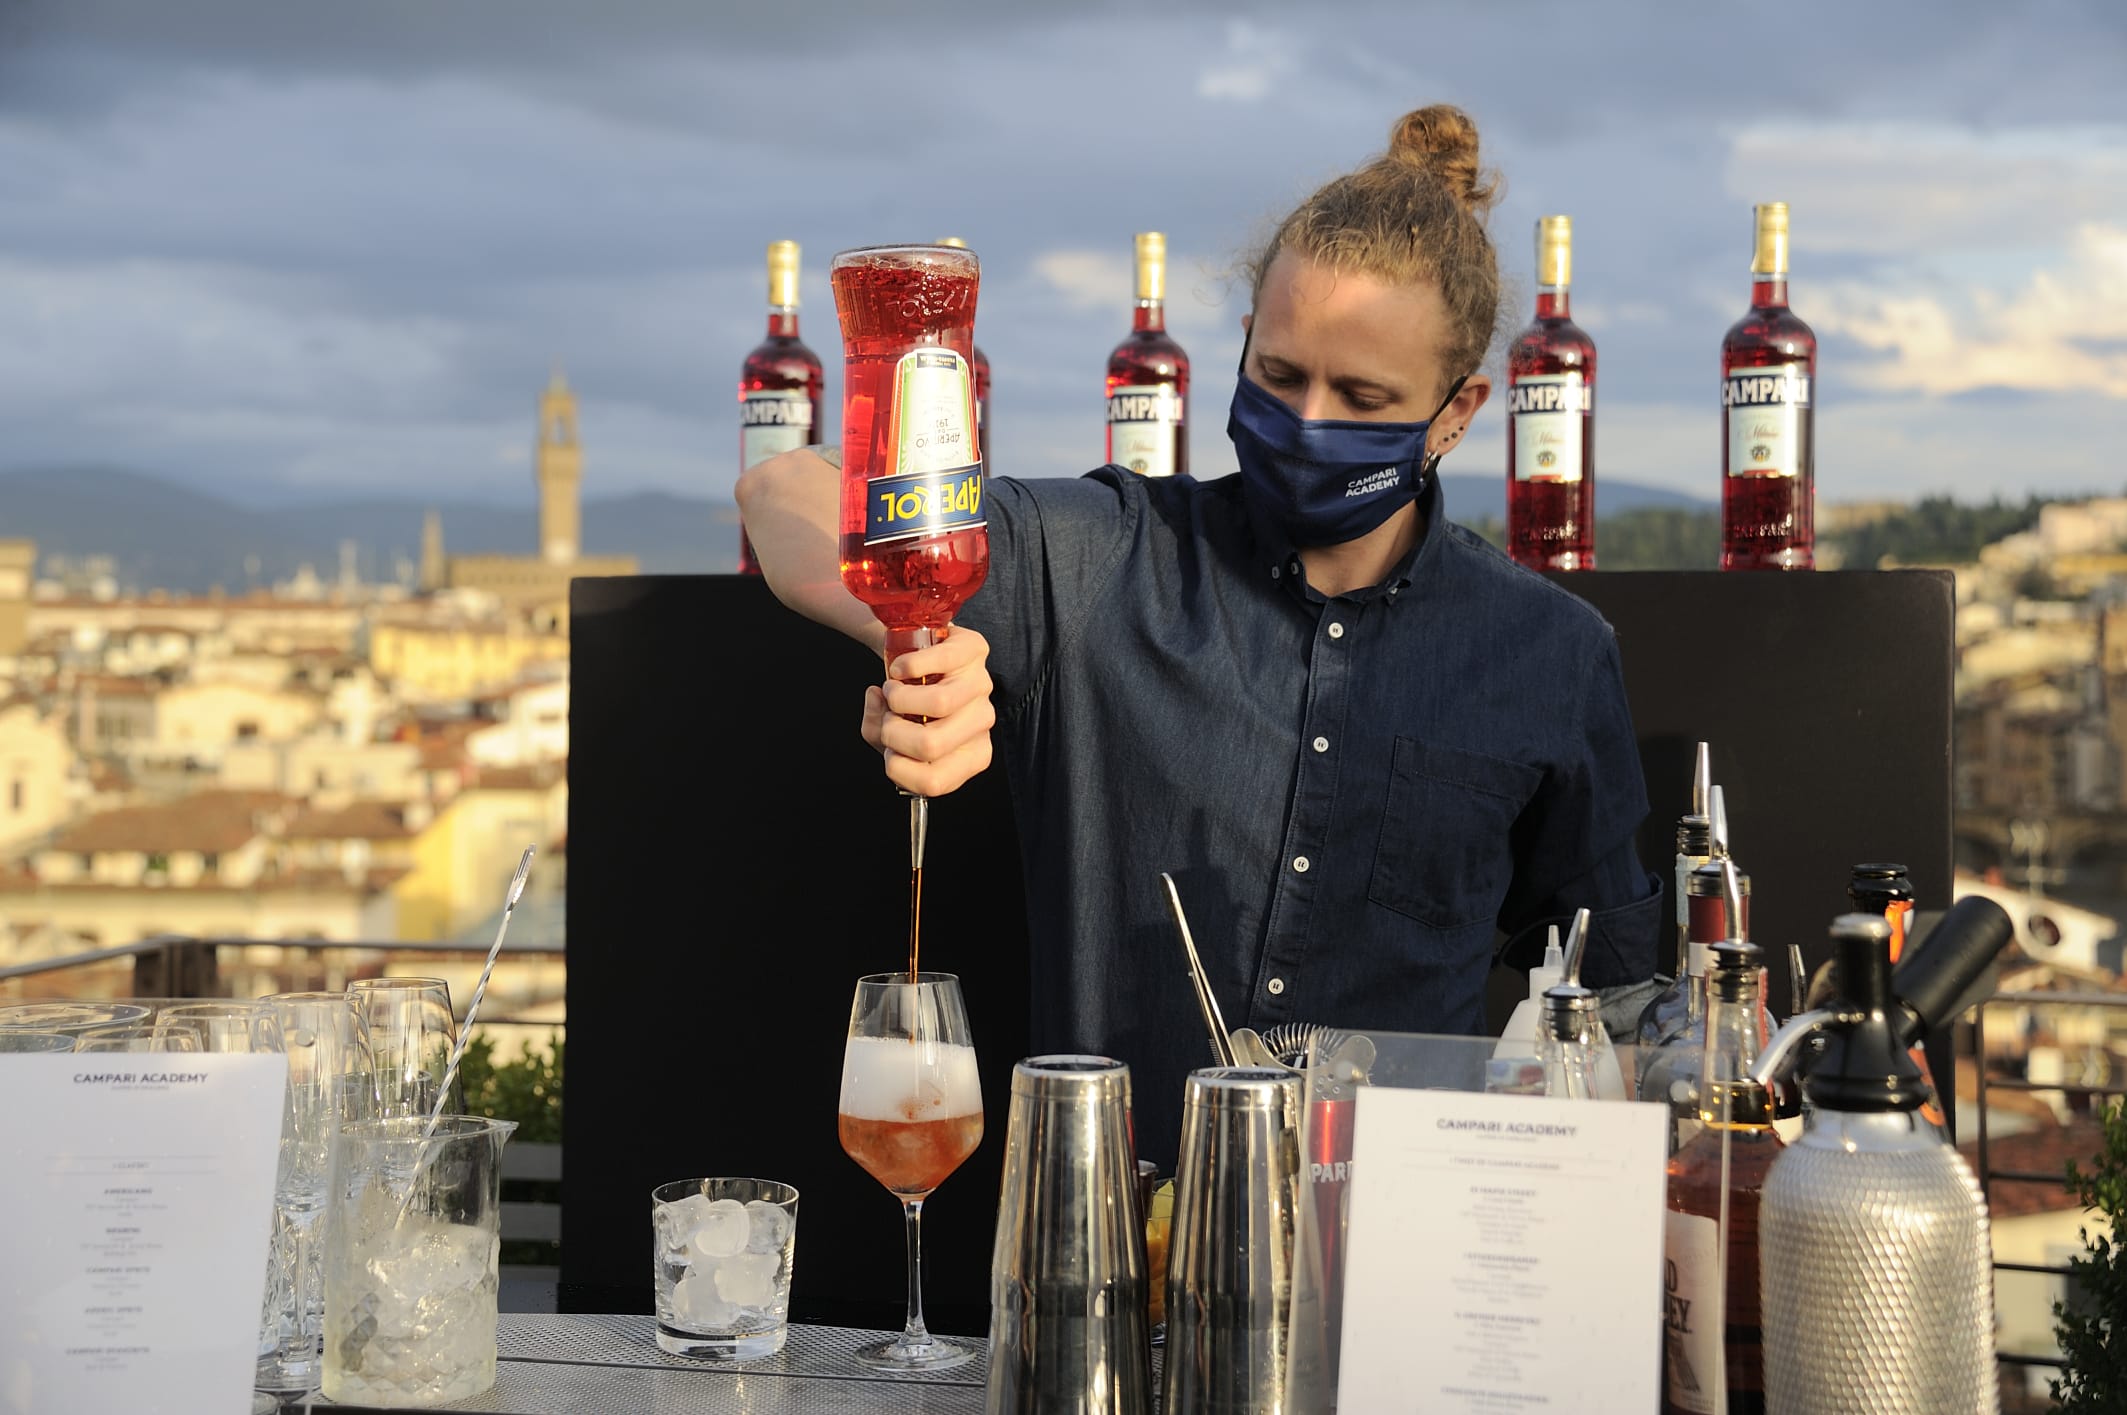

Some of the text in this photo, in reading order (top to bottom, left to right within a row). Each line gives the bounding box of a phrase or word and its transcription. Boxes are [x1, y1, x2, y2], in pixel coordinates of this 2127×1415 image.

[1344, 476, 1400, 498] ACADEMY
[1347, 466, 1397, 488] CAMPARI
[880, 474, 981, 523] APEROL
[72, 1072, 209, 1084] CAMPARI ACADEMY
[1435, 1118, 1577, 1137] CAMPARI ACADEMY
